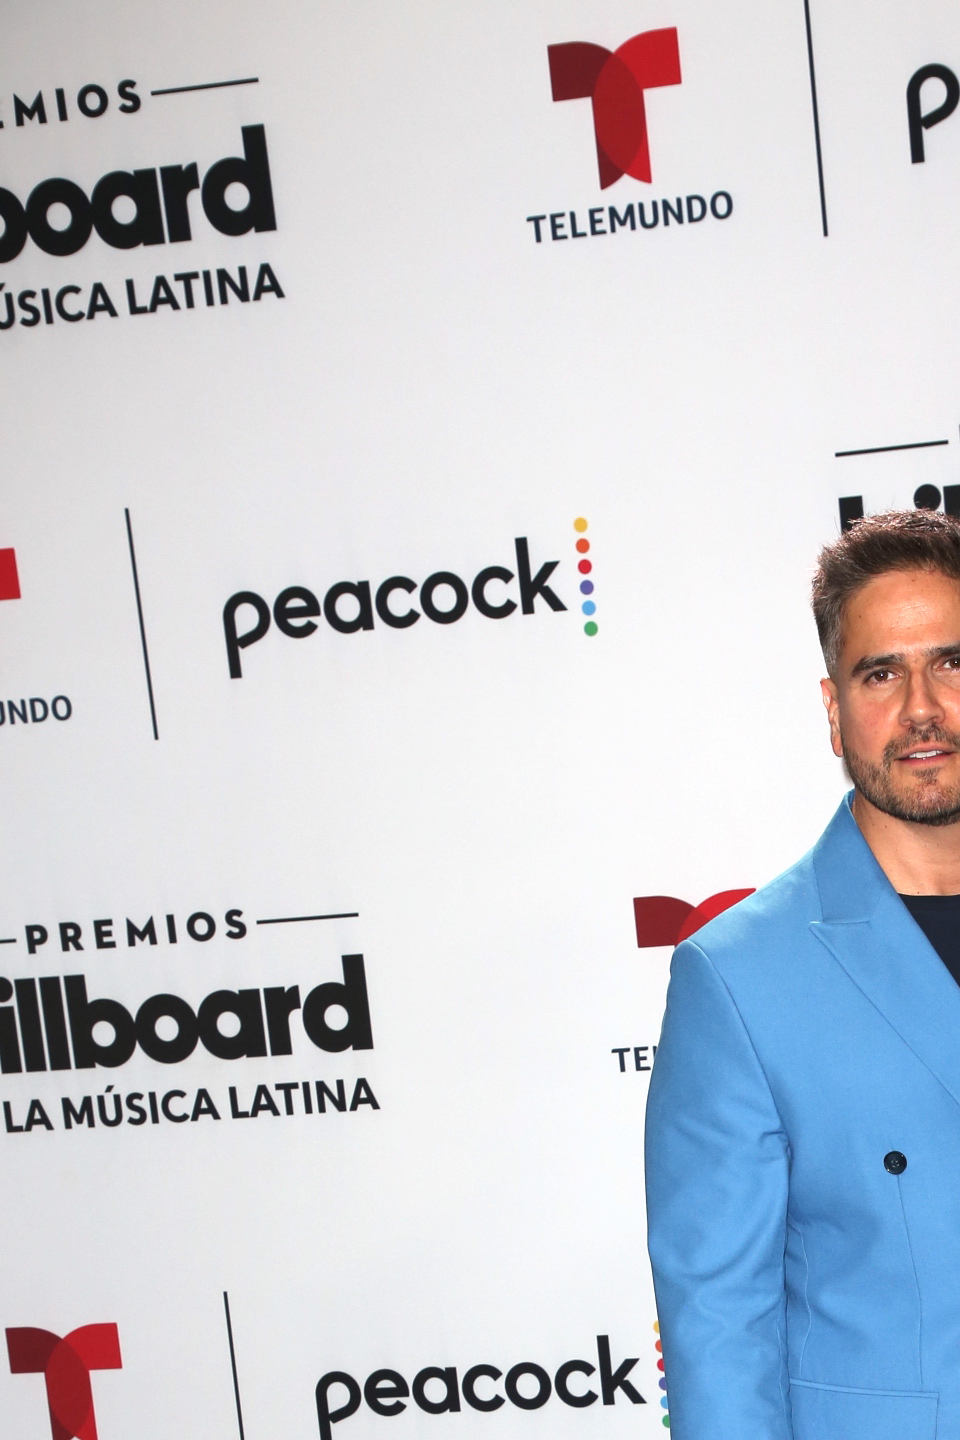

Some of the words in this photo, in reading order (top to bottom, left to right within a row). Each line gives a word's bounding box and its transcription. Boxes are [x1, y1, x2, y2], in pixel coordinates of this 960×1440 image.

[0, 79, 142, 129] MIOS
[526, 190, 733, 243] TELEMUNDO
[125, 263, 285, 316] LATINA
[222, 536, 567, 679] peacock
[25, 909, 247, 955] PREMIOS
[2, 1099, 54, 1133] LA
[61, 1084, 221, 1130] MÚSICA
[228, 1077, 380, 1119] LATINA
